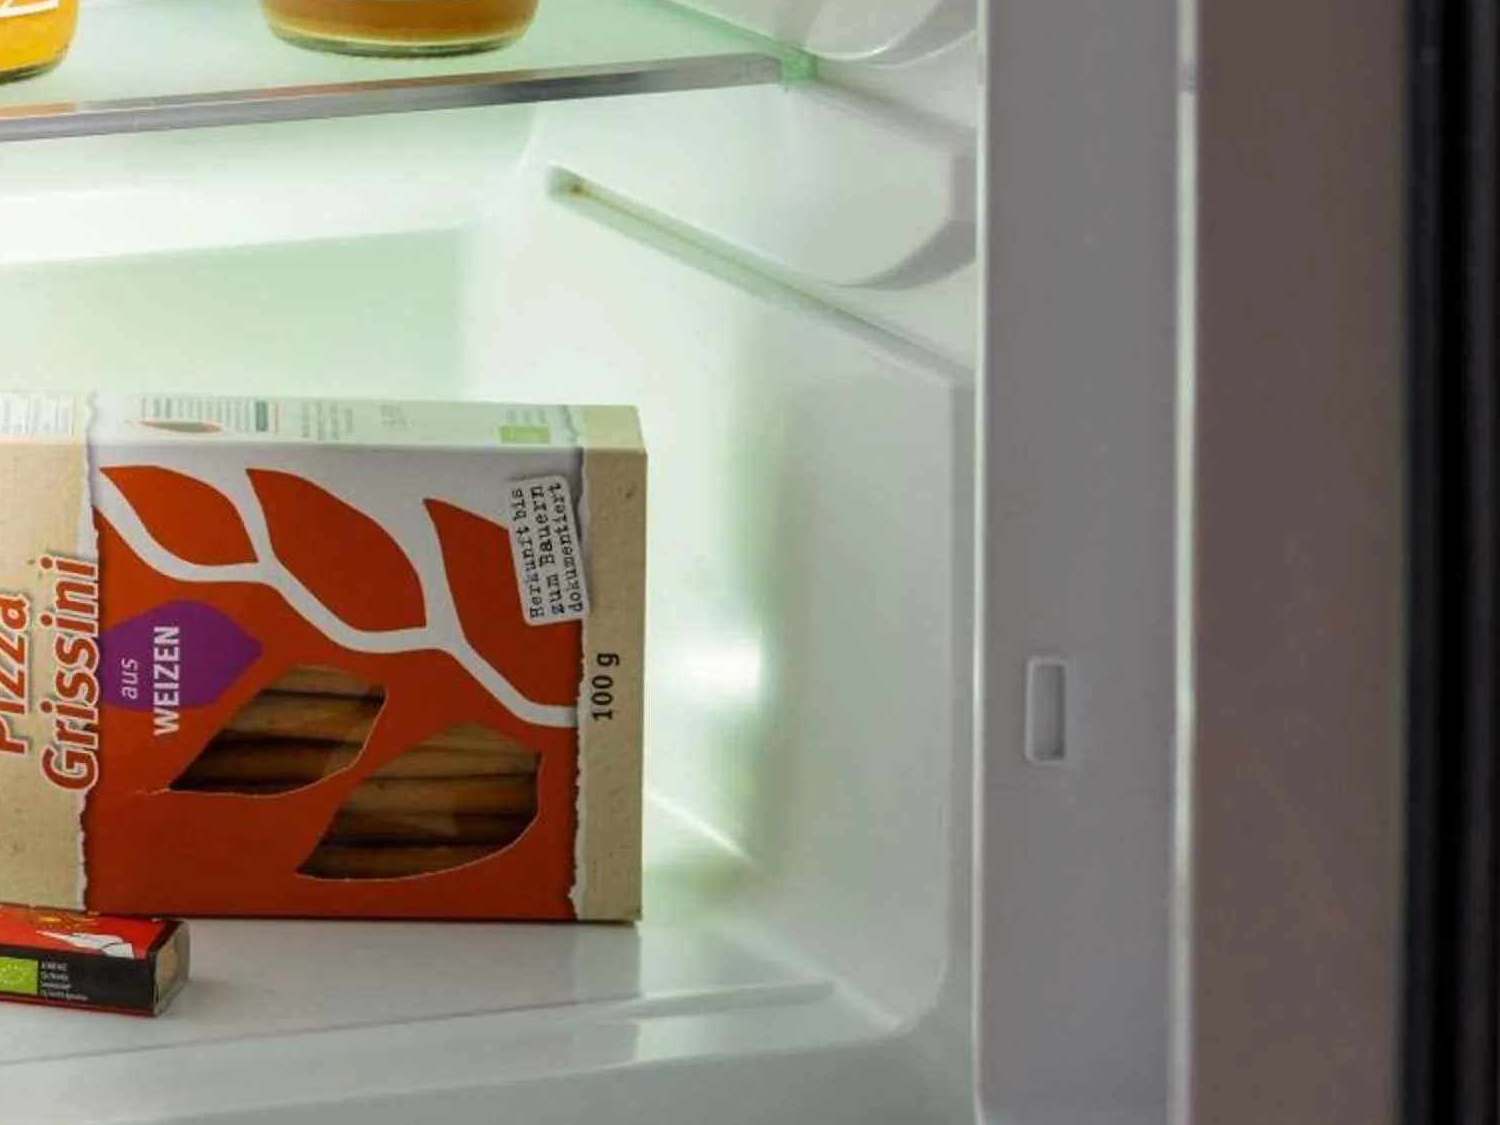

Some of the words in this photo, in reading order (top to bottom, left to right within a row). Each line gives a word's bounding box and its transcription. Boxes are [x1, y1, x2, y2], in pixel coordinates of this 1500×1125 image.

[511, 487, 528, 522] bis
[530, 485, 556, 565] Bauern
[516, 526, 545, 618] Herkunft
[548, 482, 583, 613] dokumentiert
[547, 573, 565, 615] zum
[38, 556, 100, 793] Grissini
[120, 658, 139, 700] aus
[153, 625, 181, 736] WEIZEN
[596, 652, 620, 667] g
[591, 674, 614, 722] 100
